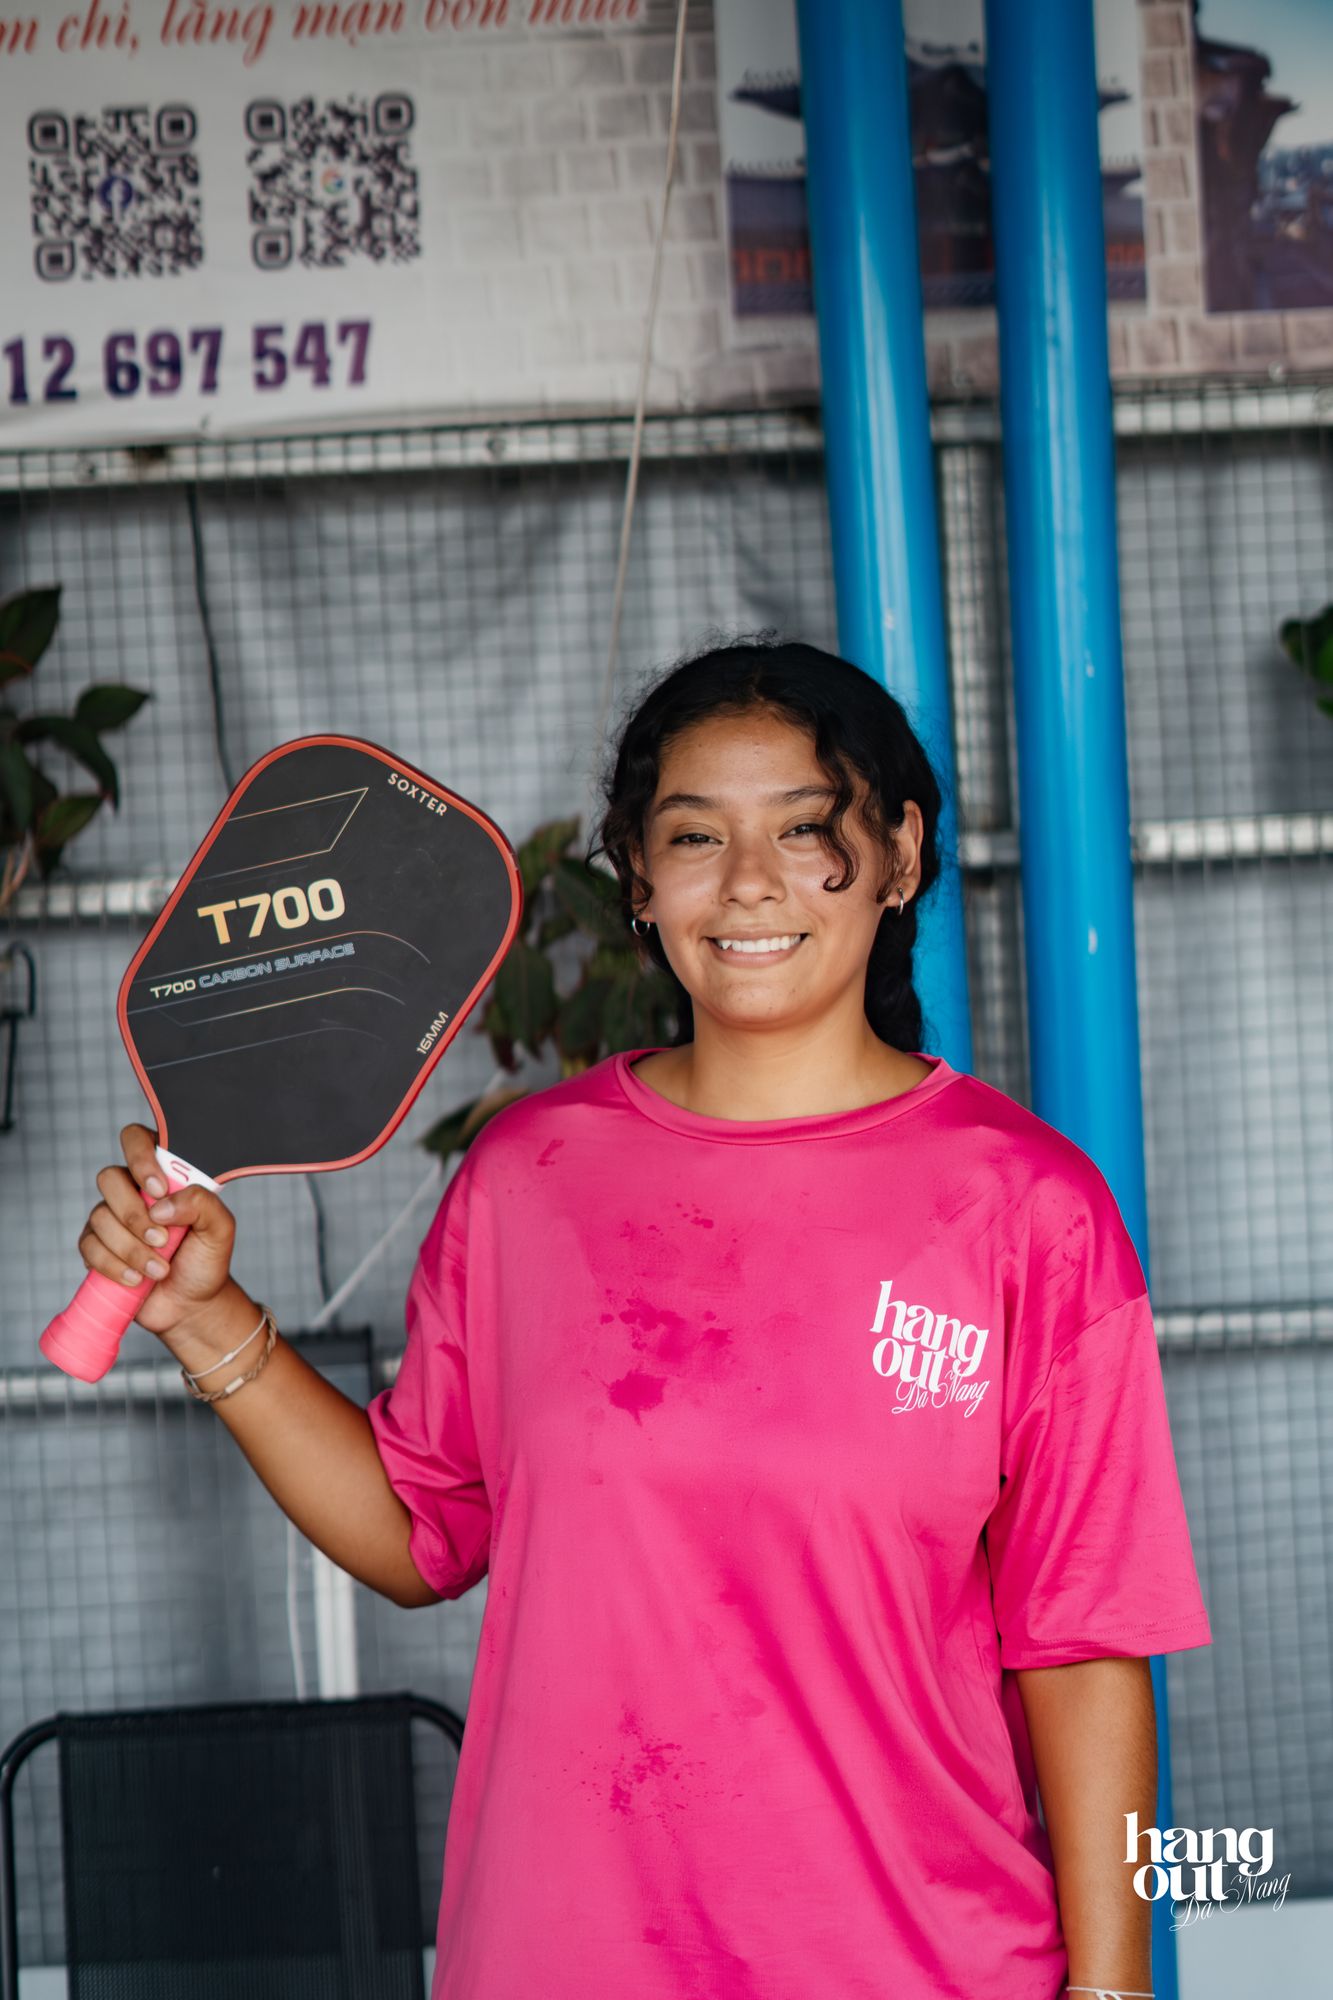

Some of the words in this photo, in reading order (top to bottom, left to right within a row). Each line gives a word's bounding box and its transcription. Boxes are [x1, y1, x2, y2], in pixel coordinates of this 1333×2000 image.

[2, 334, 77, 405] 12
[103, 328, 223, 400] 697
[252, 319, 371, 391] 547
[387, 772, 448, 816] SOXTER
[197, 878, 346, 945] T700
[150, 979, 196, 999] T700
[199, 960, 273, 988] CARBON
[274, 942, 356, 972] SURFACE
[416, 1011, 449, 1055] 16MM
[869, 1280, 989, 1377] hang
[872, 1337, 949, 1394] out
[931, 1369, 991, 1418] Nang
